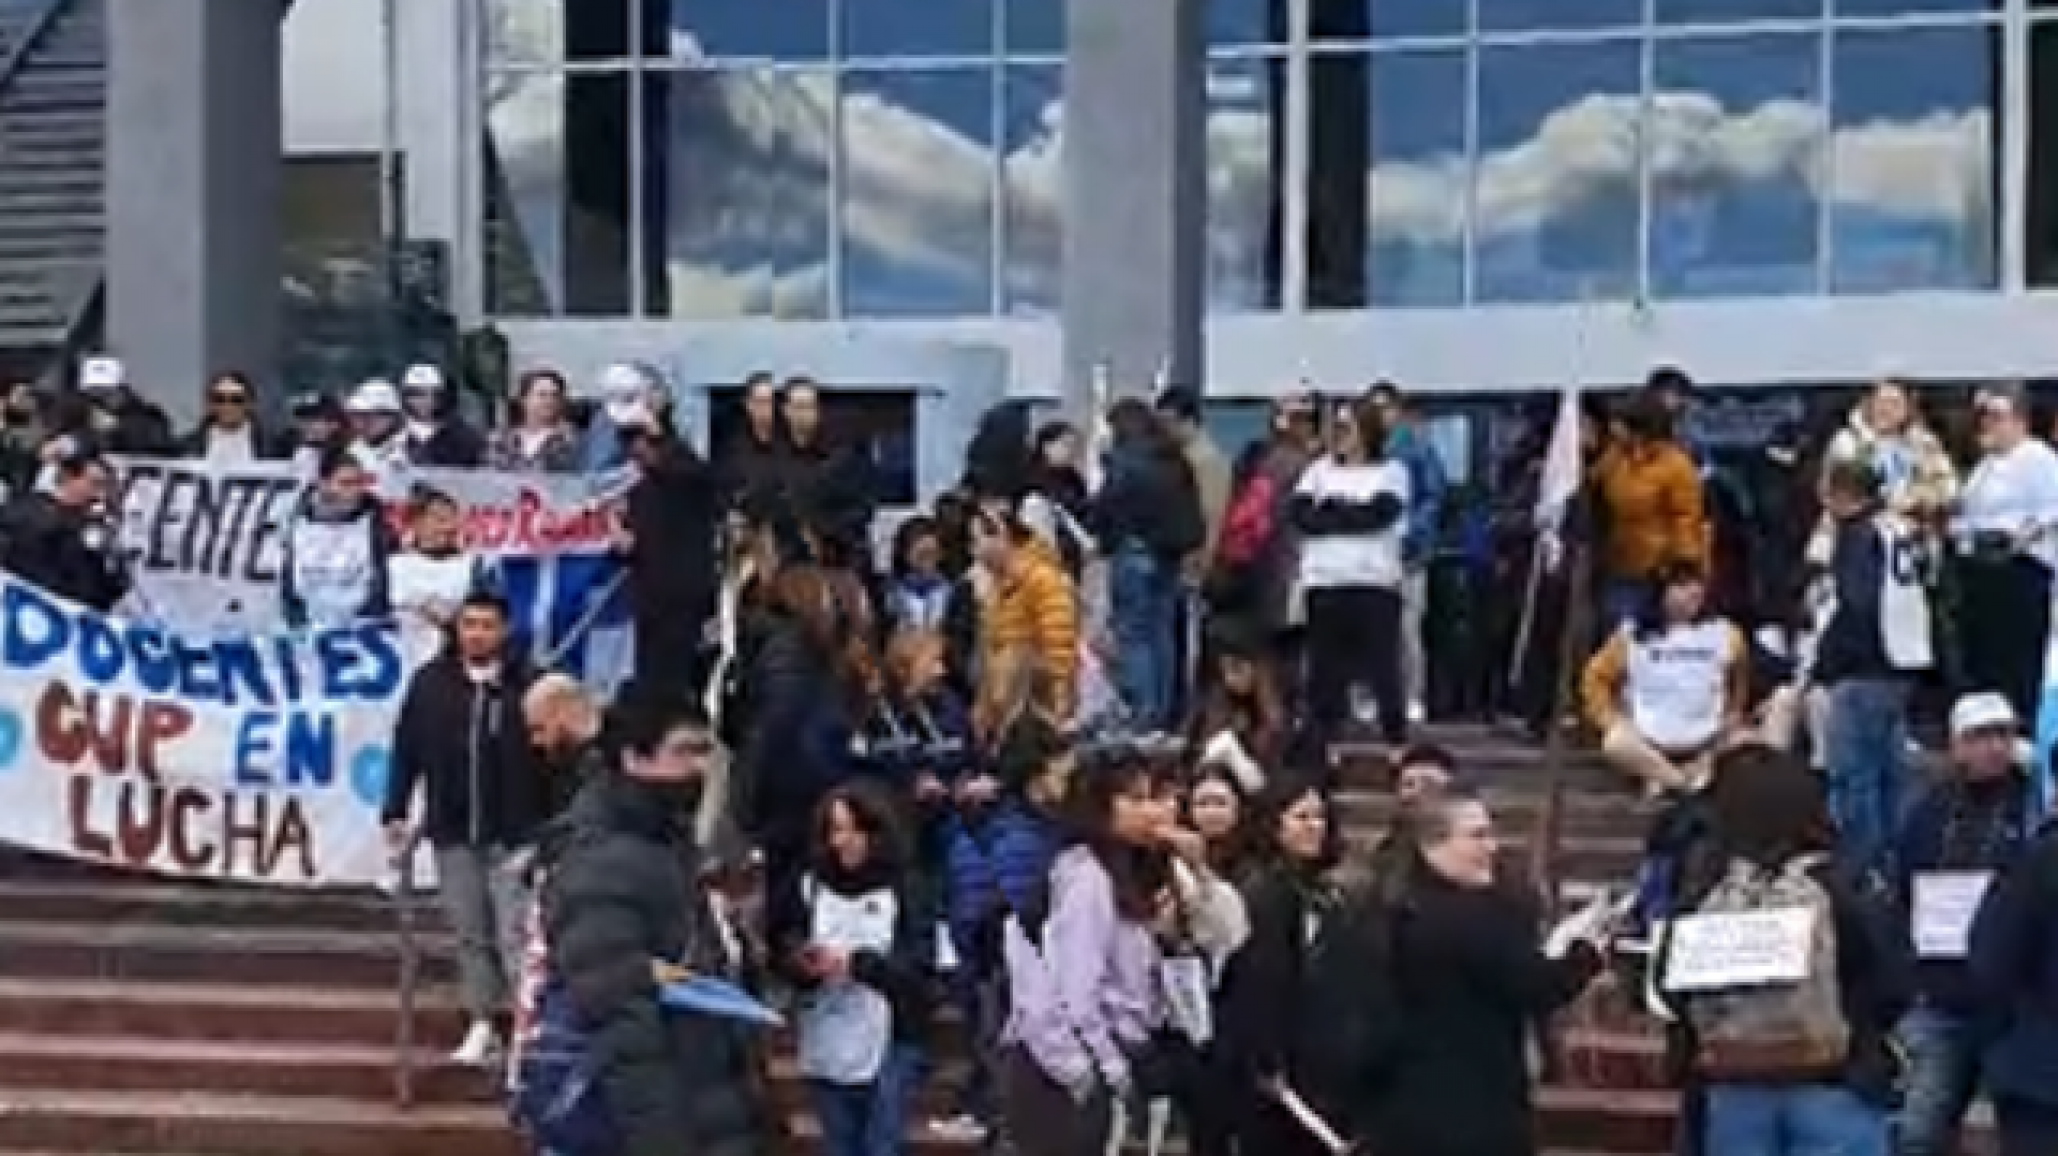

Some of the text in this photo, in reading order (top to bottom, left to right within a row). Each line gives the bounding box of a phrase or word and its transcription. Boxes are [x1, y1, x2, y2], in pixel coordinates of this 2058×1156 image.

[2, 582, 403, 706] DOCENTES
[236, 711, 334, 788] EN
[70, 774, 317, 879] LUCHA
